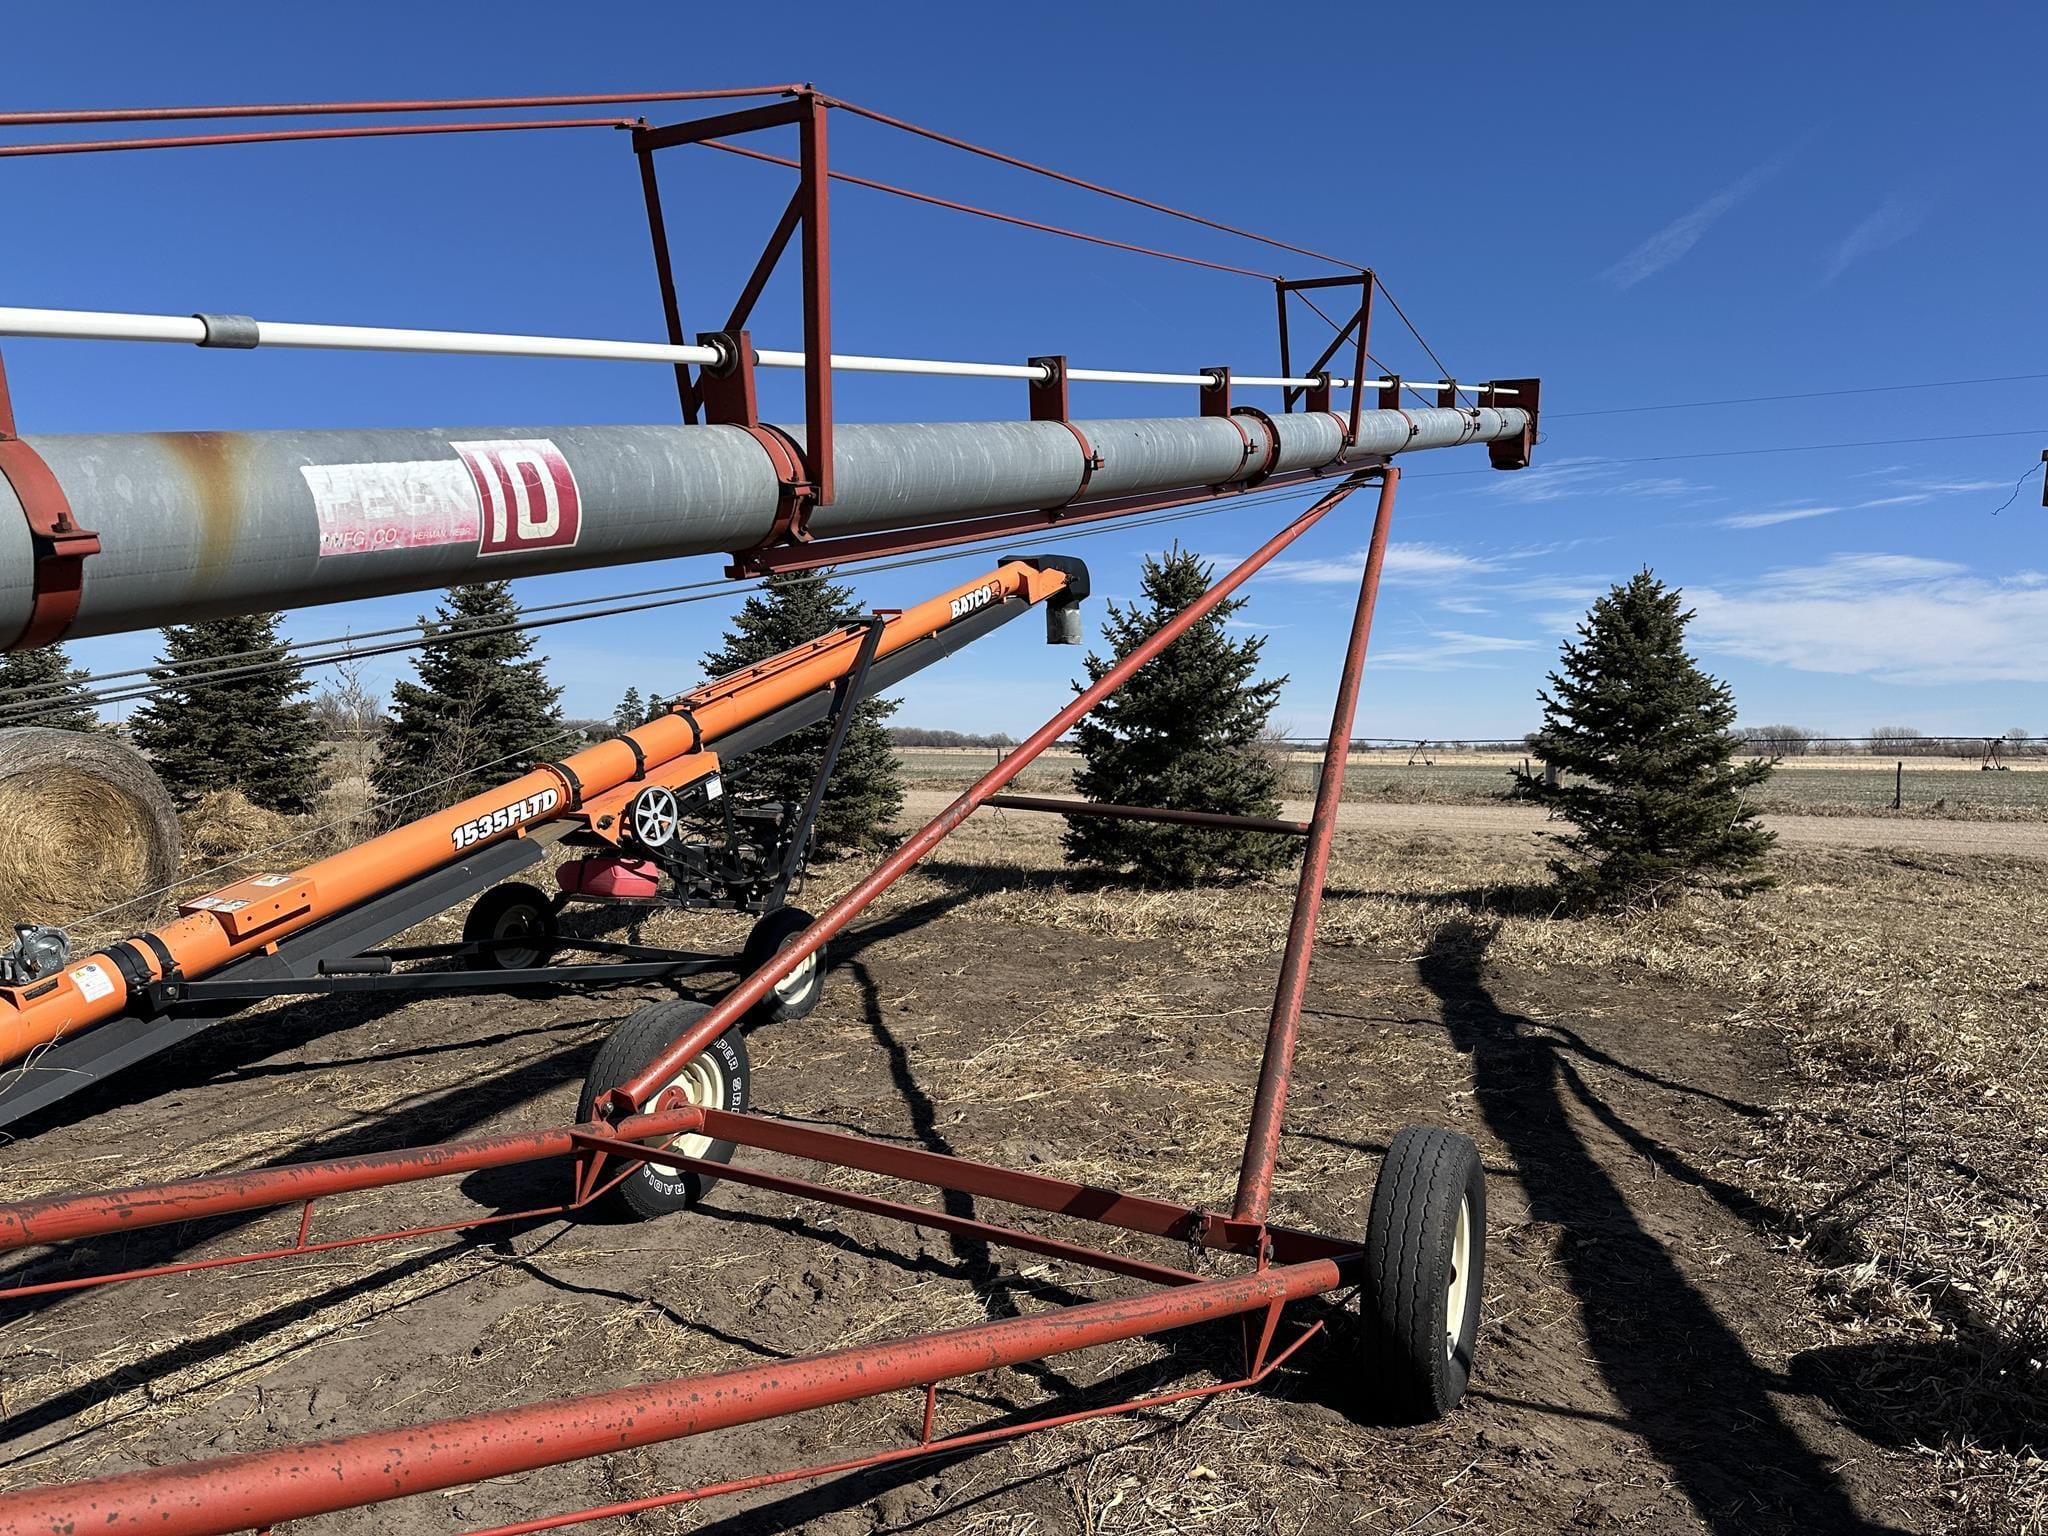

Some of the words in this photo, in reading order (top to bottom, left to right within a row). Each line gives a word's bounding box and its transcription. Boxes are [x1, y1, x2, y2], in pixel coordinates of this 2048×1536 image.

[477, 447, 560, 543] 10
[949, 584, 992, 621] BATCO
[451, 787, 559, 851] 1535FLTD
[713, 1037, 739, 1071] PER
[643, 1164, 686, 1196] RADIA
